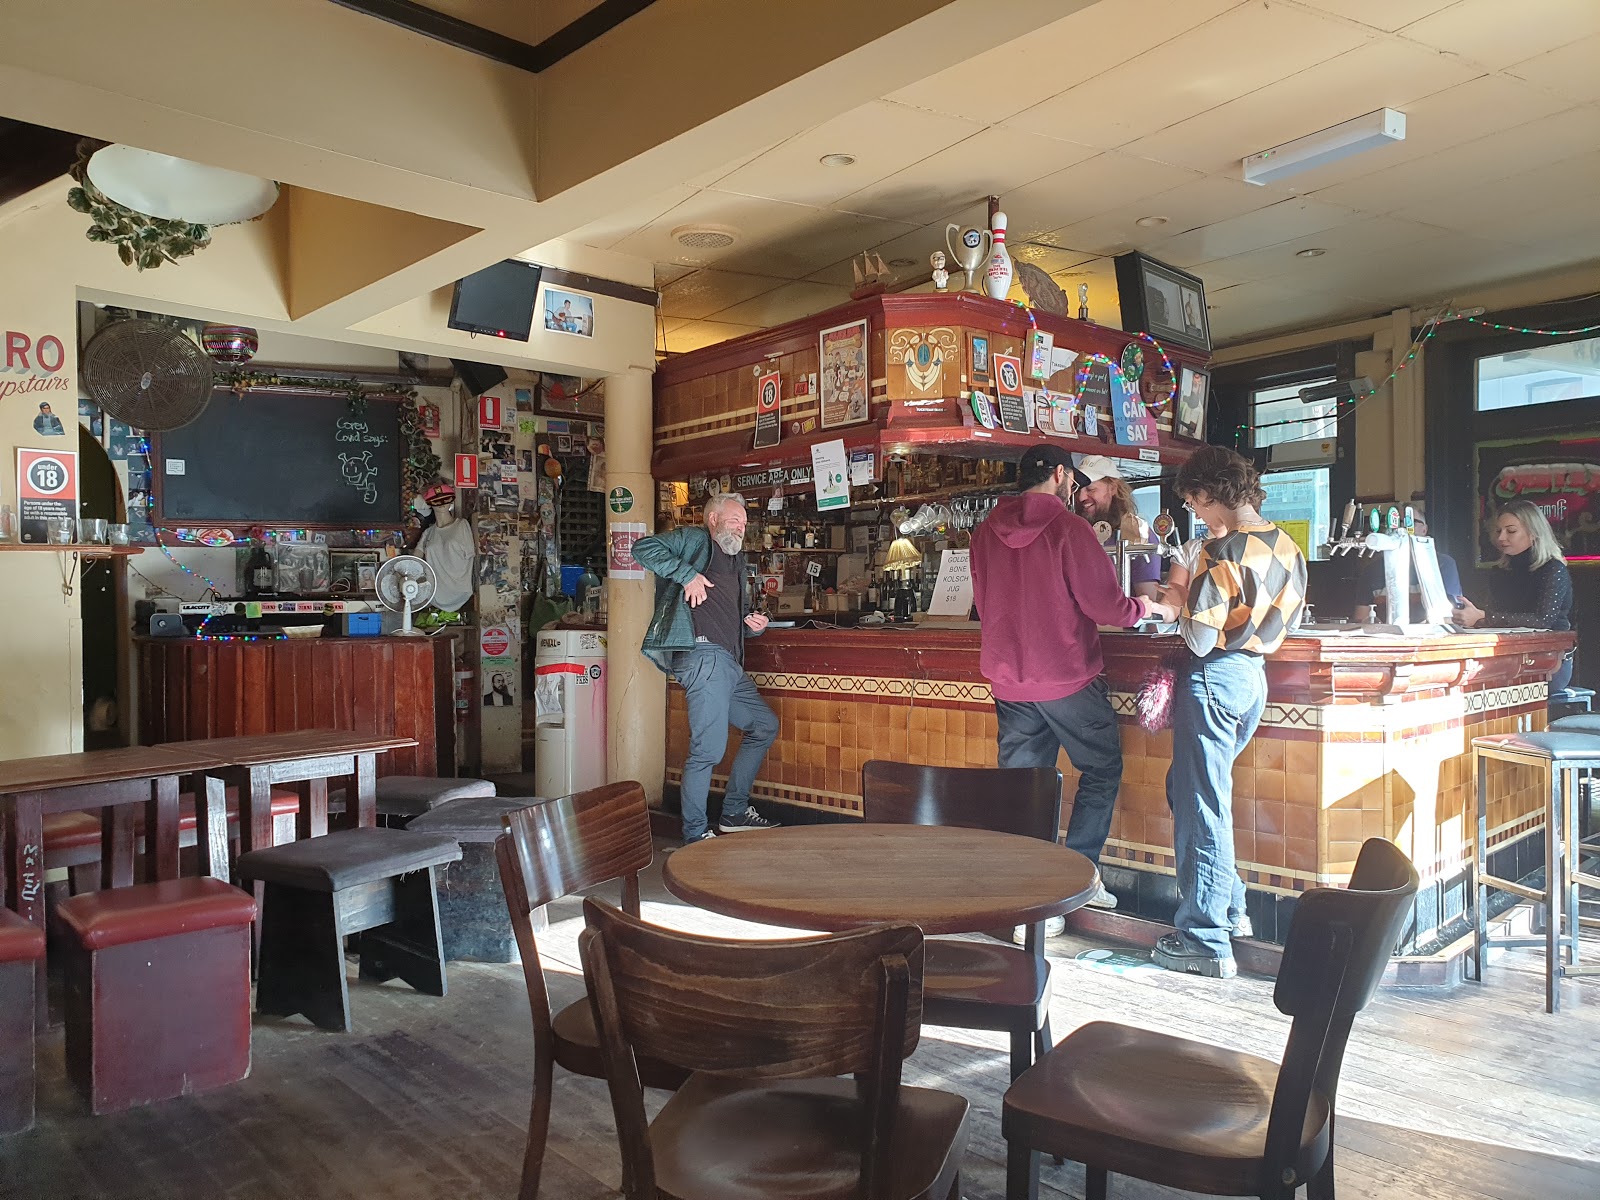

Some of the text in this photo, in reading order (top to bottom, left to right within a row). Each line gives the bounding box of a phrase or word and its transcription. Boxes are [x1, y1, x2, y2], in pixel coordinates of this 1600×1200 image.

[6, 331, 65, 372] RO
[764, 389, 773, 403] 18
[1122, 401, 1147, 418] CAN
[1126, 424, 1148, 441] SAY
[37, 470, 58, 488] 18
[737, 472, 767, 487] SERVICE
[791, 466, 812, 480] ONLY
[810, 564, 818, 574] 15
